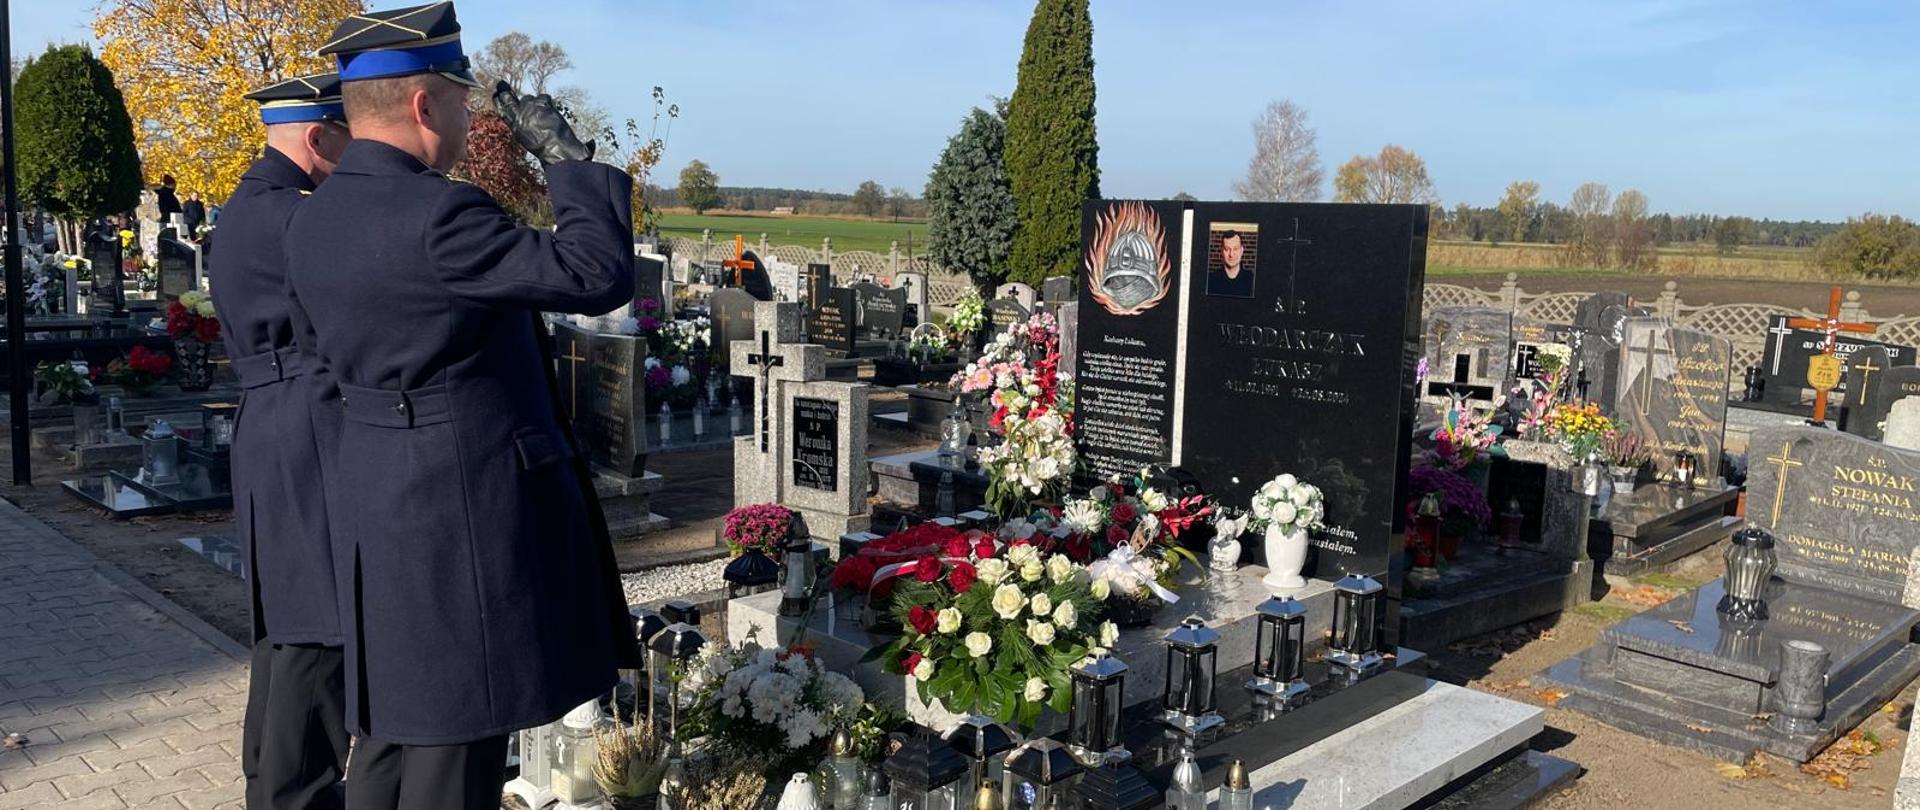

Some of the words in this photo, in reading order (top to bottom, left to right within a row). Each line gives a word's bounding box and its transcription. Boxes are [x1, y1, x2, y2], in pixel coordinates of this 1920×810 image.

[799, 432, 832, 450] Weronika
[1834, 465, 1916, 492] NOWAK
[1831, 485, 1912, 509] STEFANIA
